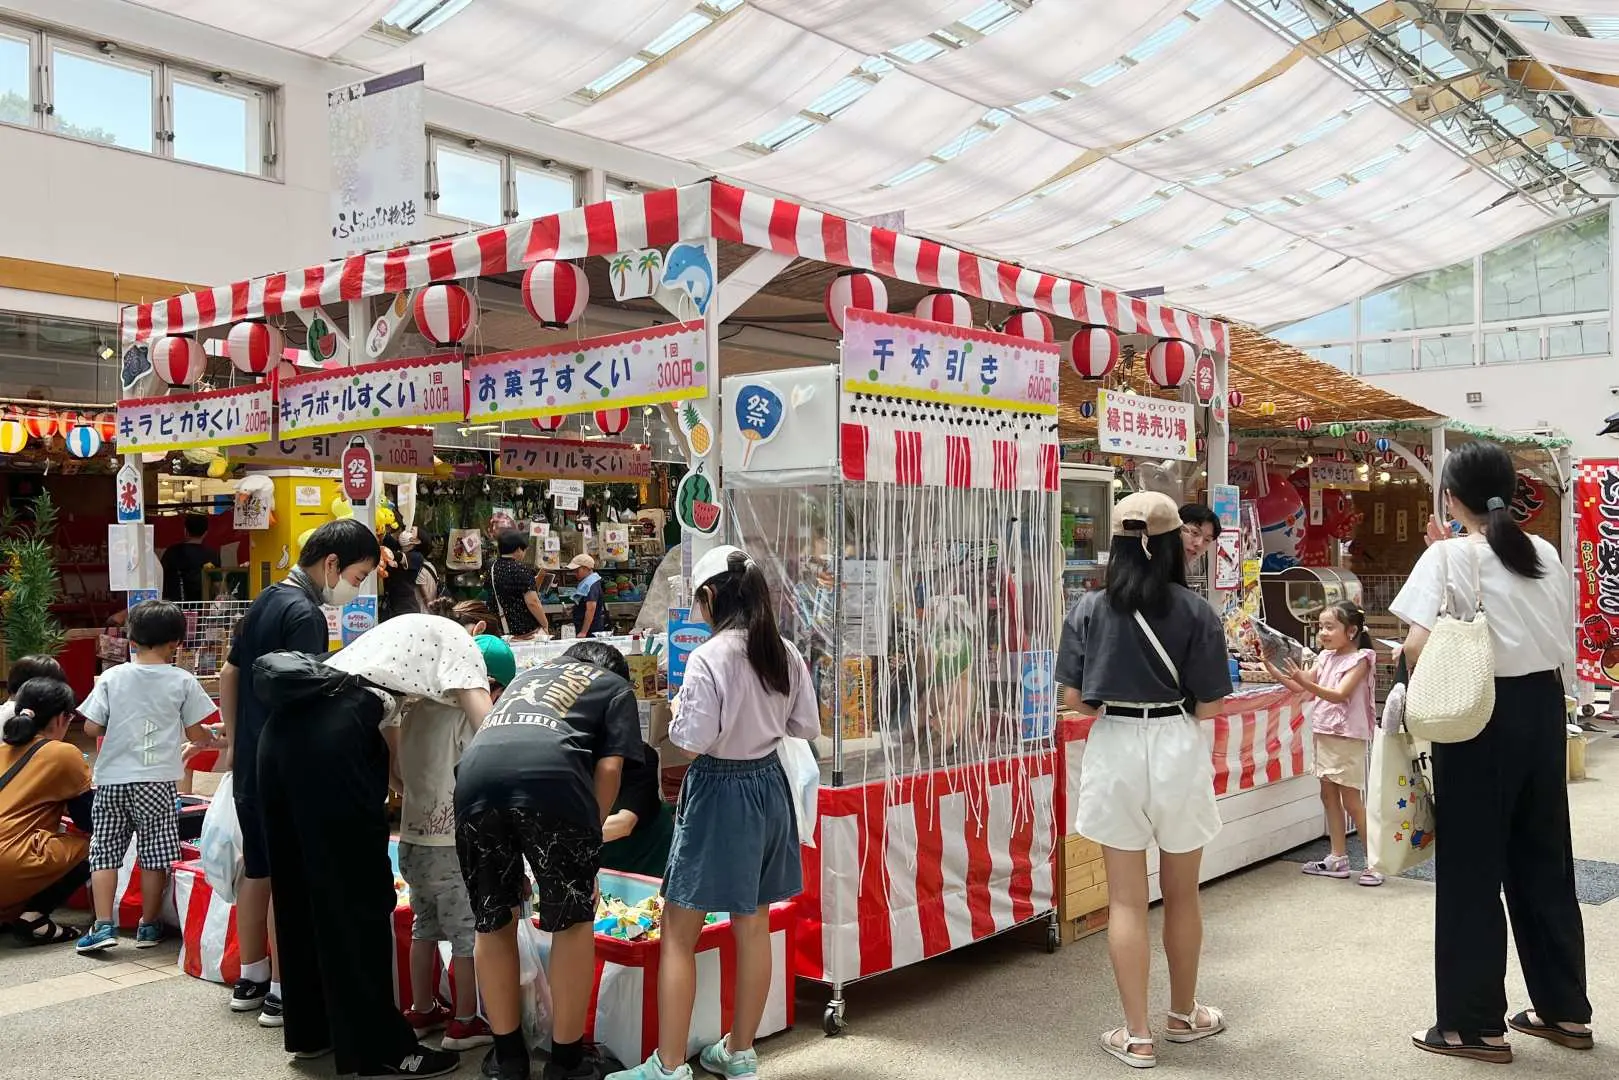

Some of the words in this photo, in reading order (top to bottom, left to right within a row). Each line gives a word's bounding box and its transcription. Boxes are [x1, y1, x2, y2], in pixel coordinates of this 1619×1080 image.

[663, 343, 679, 358] 1回
[872, 339, 999, 385] 千本引き
[428, 372, 443, 385] 1回
[478, 357, 631, 401] お菓子すくい
[657, 358, 693, 389] 300円
[1199, 366, 1212, 391] 祭
[423, 386, 449, 411] 300円
[1027, 375, 1051, 401] 600円
[249, 398, 260, 410] 1回
[280, 382, 416, 422] キャラボールすくい
[745, 394, 770, 428] 祭
[119, 407, 240, 438] キラピカすくい
[245, 410, 268, 433] 200円
[1107, 407, 1188, 442] 縁日券売り場
[389, 449, 418, 466] 100円
[503, 449, 623, 472] アクリルすくい
[348, 458, 368, 488] 祭
[518, 714, 558, 730] TOKYO
